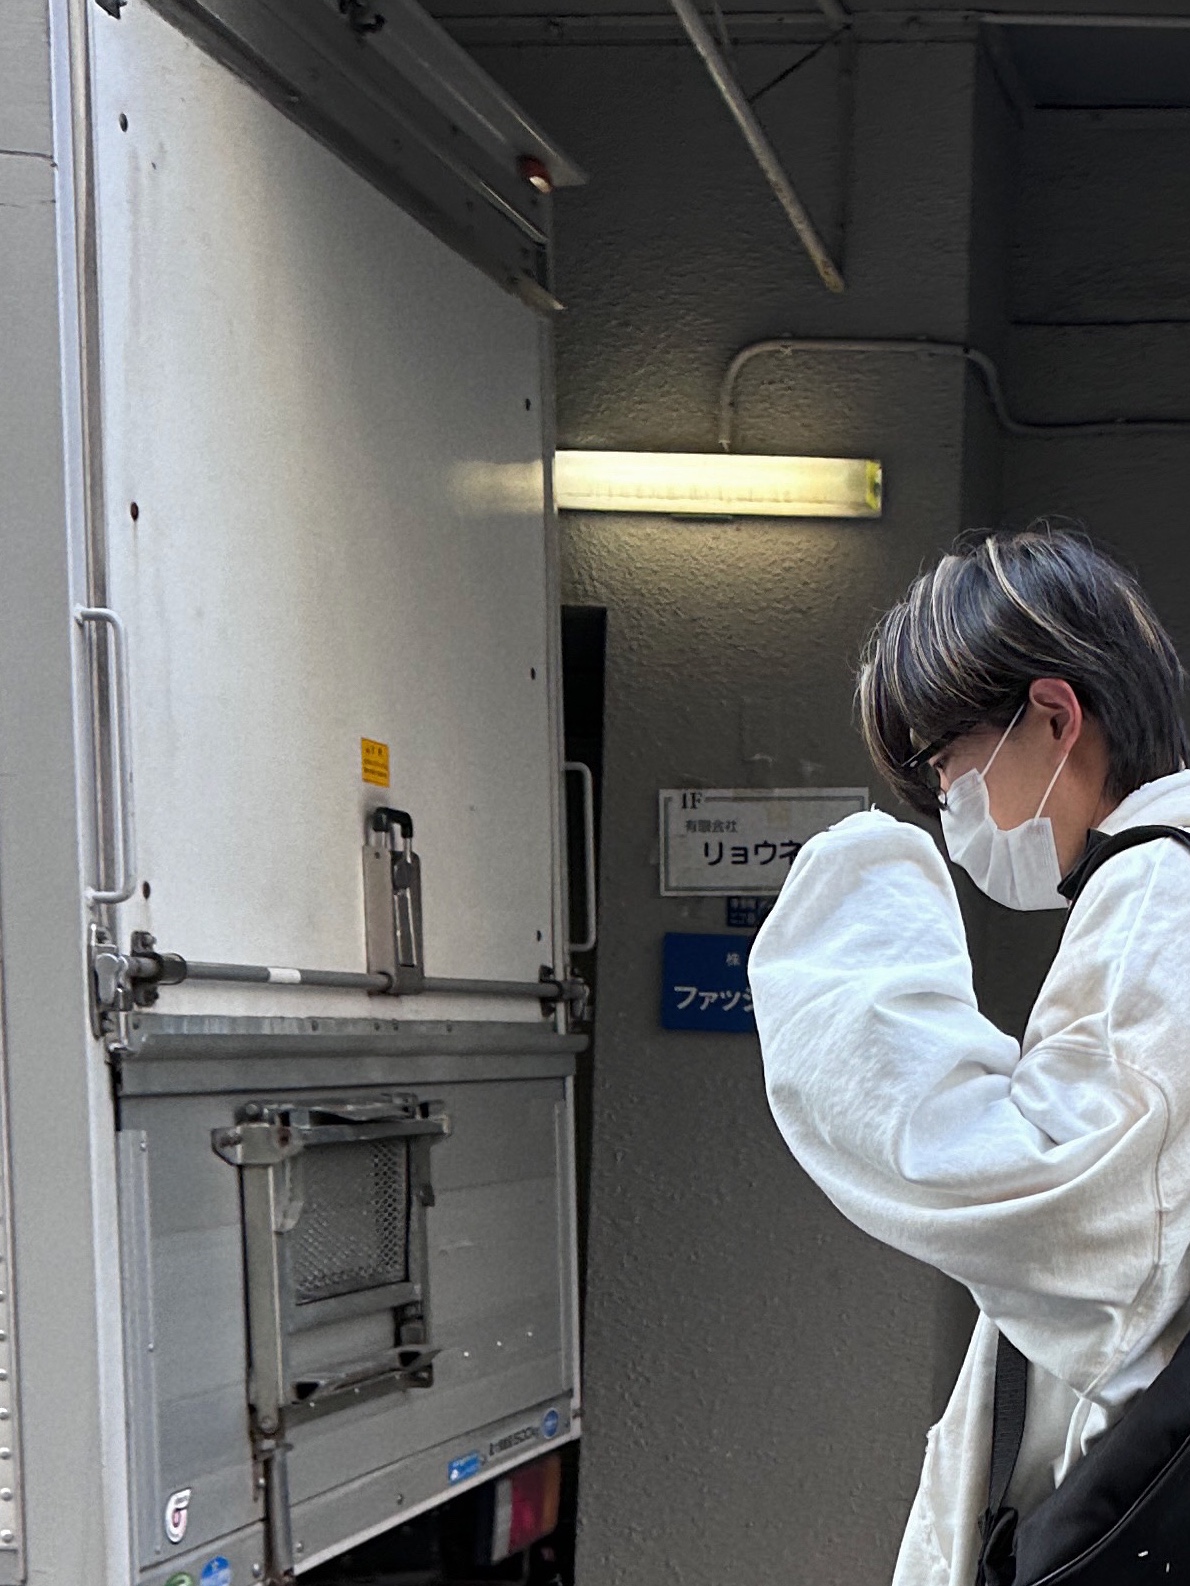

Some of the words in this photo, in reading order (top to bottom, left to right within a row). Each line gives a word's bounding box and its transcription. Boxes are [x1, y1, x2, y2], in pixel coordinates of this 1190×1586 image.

[680, 791, 703, 810] 1F
[685, 819, 738, 833] 有限会社
